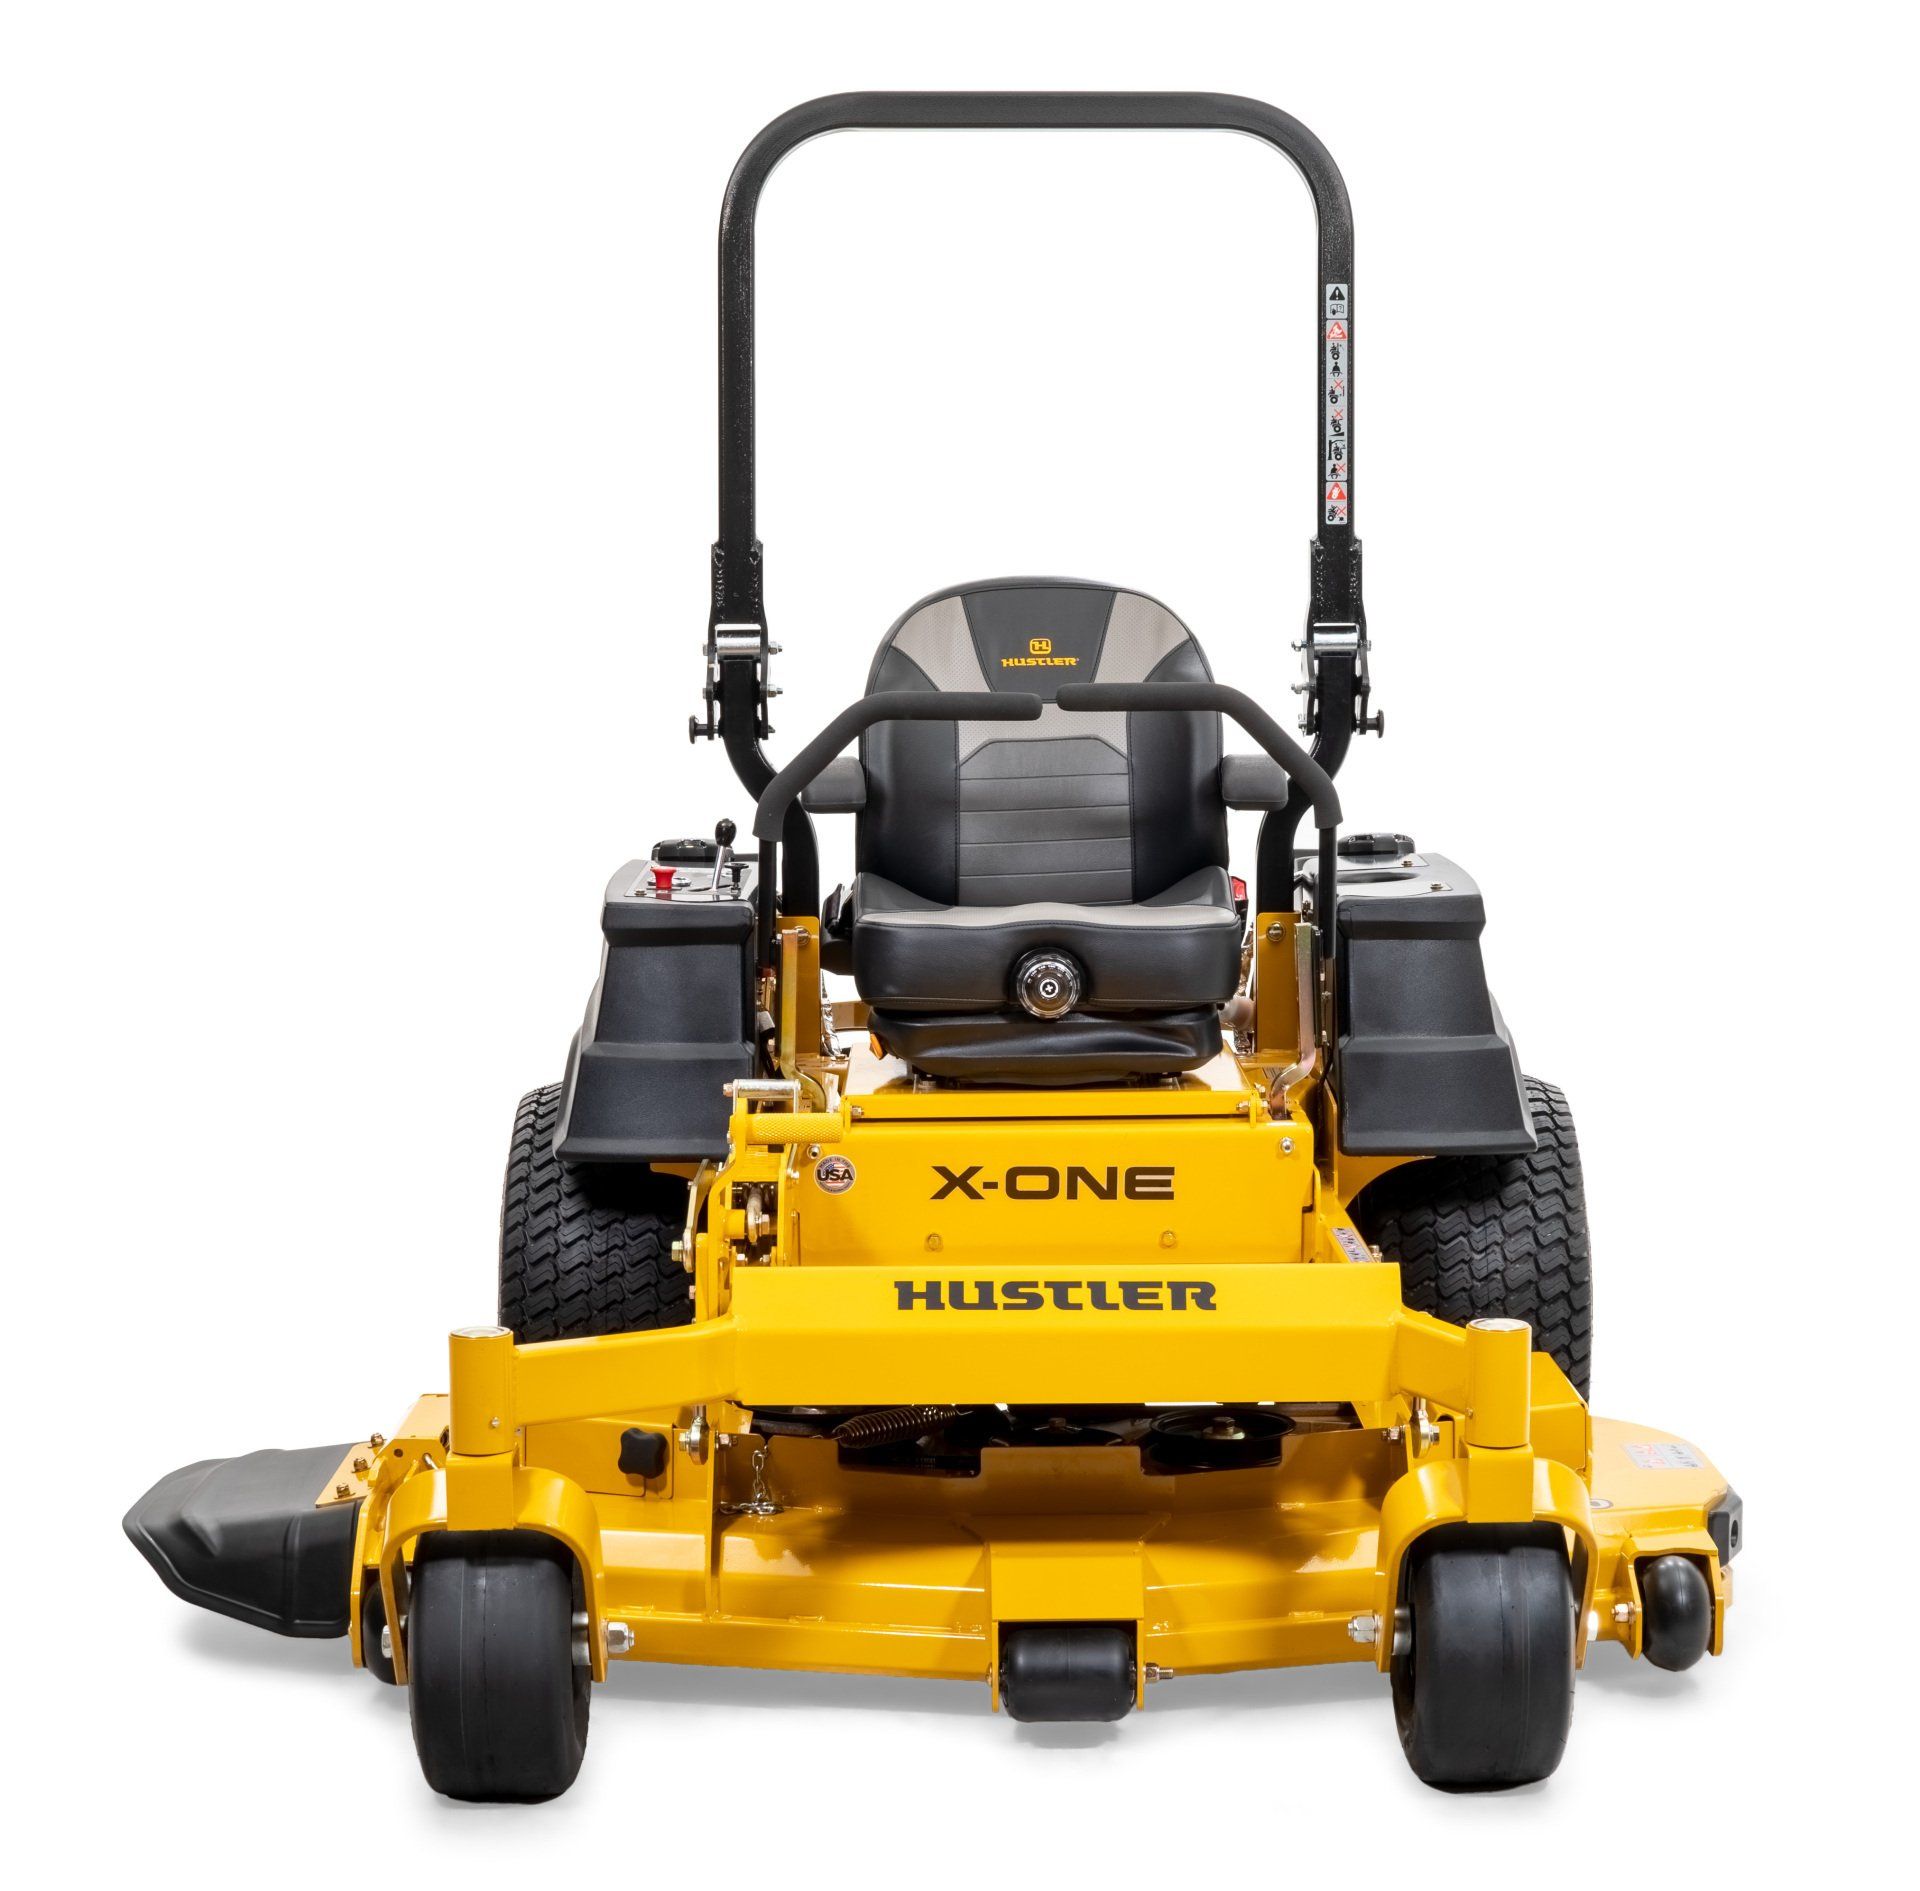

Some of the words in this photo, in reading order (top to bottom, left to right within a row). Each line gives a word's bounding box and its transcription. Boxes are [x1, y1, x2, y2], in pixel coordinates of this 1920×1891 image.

[1001, 657, 1077, 667] HUSTLER
[817, 1168, 853, 1181] USA
[930, 1165, 1175, 1200] X-ONE
[894, 1281, 1216, 1310] HUSTLER
